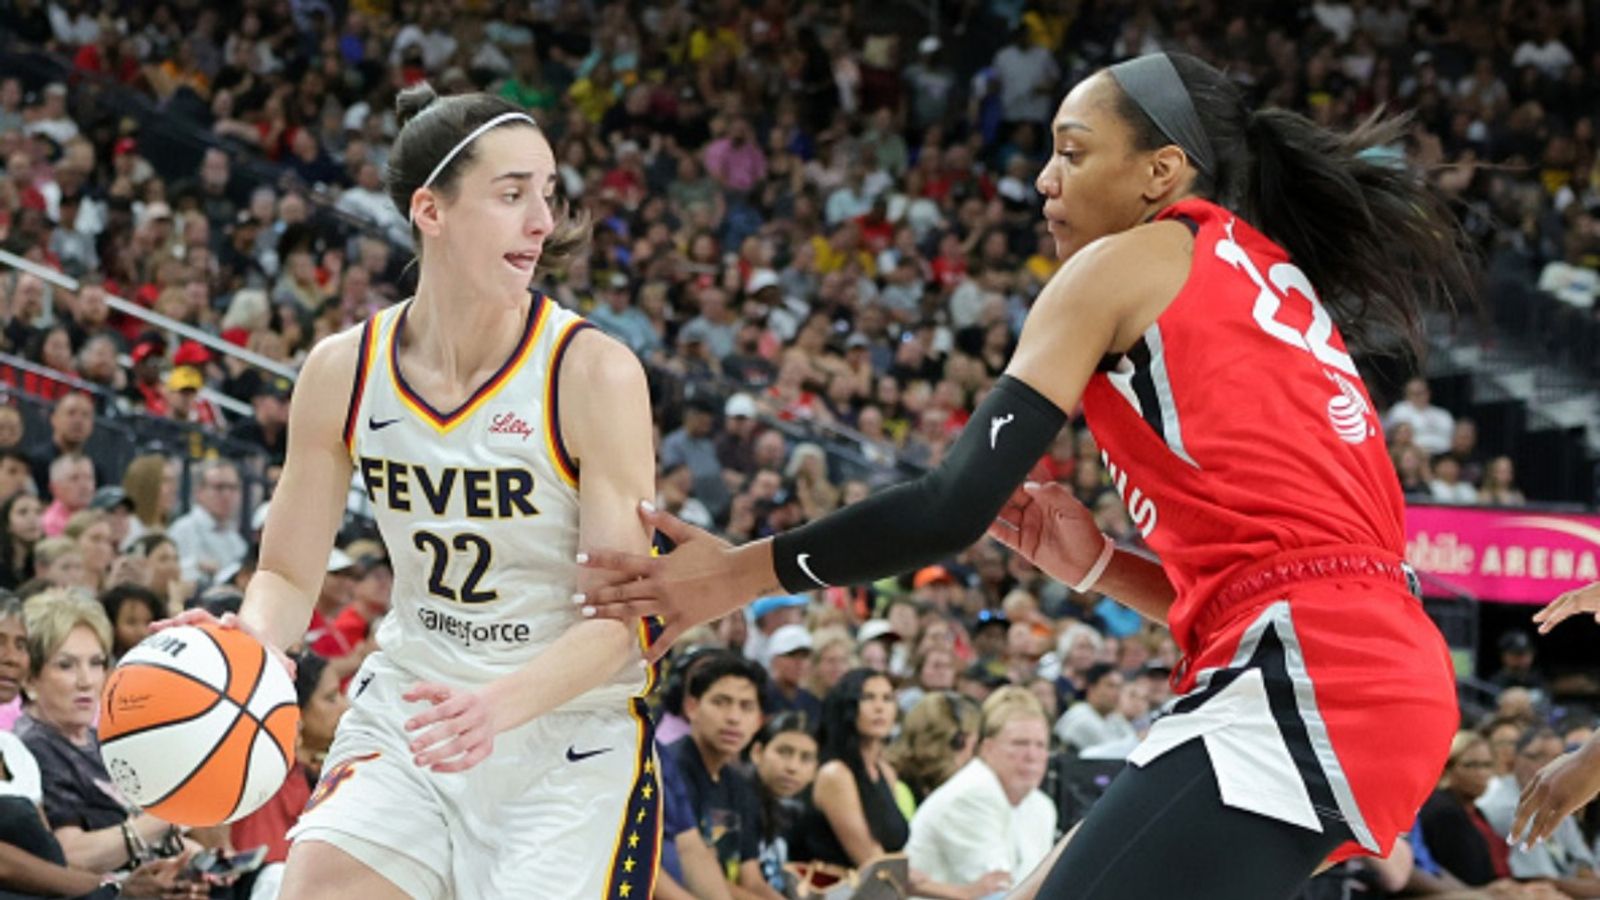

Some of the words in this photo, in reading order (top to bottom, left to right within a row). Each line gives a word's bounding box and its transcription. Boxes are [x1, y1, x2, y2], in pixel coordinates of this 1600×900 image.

[1215, 238, 1360, 378] 22
[488, 411, 535, 442] Lilly
[360, 456, 541, 519] FEVER
[412, 529, 499, 604] 22
[1480, 544, 1598, 581] ARENA
